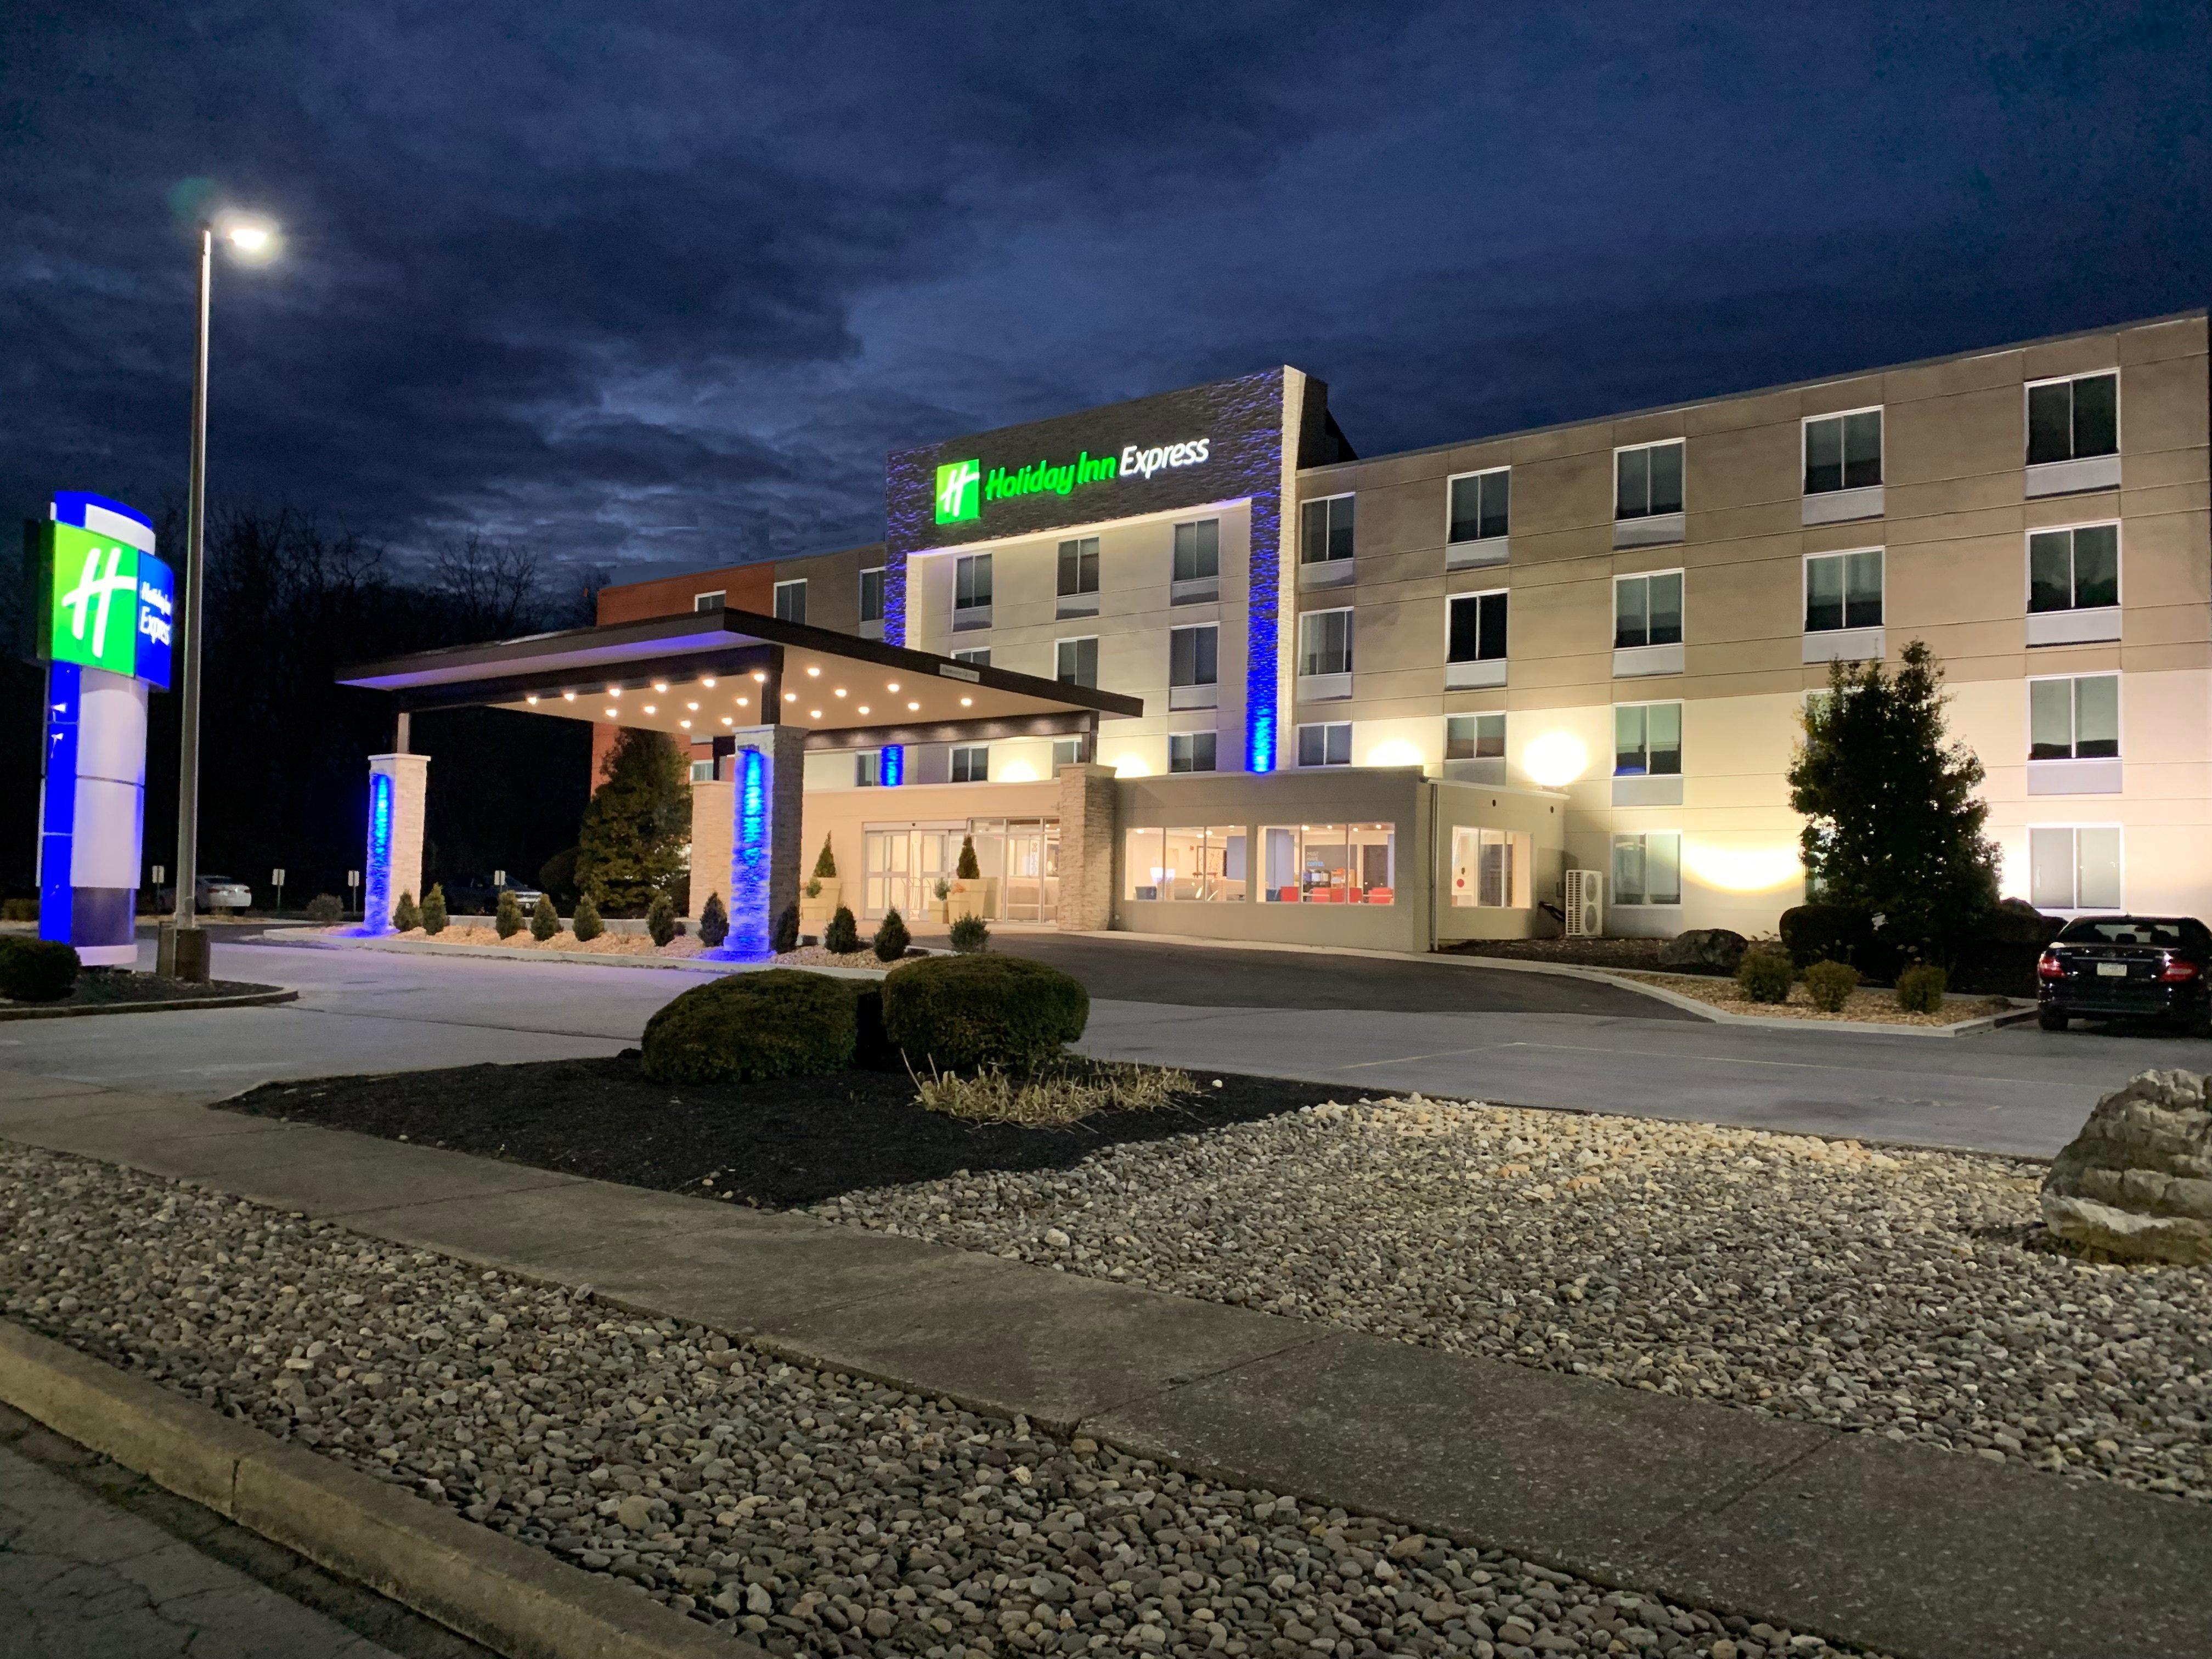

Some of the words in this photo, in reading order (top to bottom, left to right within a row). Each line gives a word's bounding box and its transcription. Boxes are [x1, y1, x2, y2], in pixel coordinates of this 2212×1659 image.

[985, 460, 1075, 500] Holiday
[1077, 451, 1116, 484] Inn
[1119, 438, 1210, 479] Express
